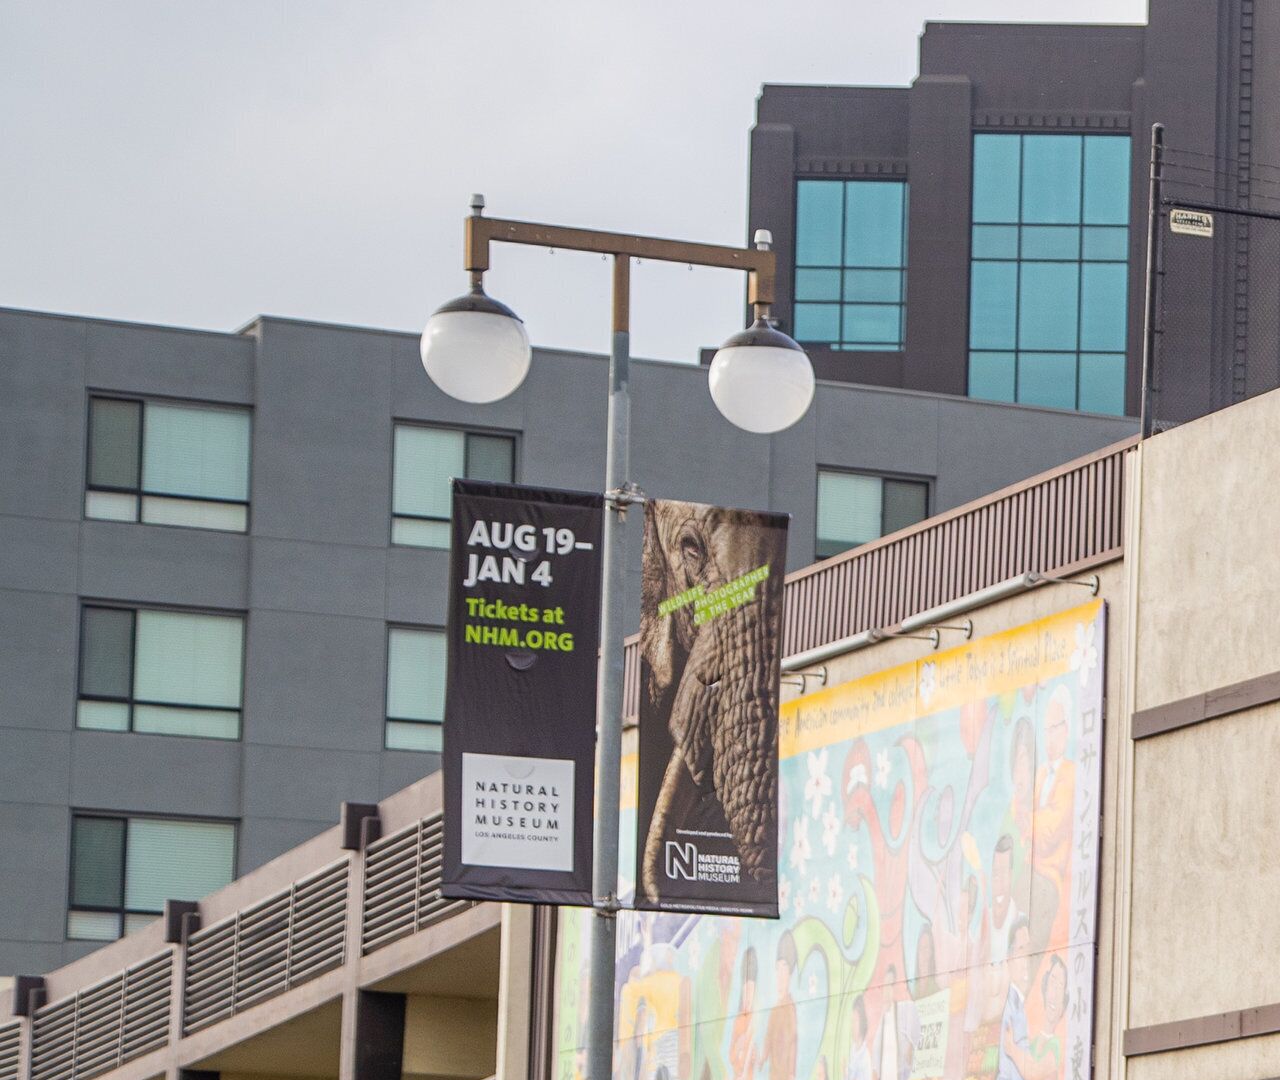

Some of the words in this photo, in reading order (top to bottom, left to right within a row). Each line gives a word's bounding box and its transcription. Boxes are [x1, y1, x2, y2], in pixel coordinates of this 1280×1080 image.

[467, 520, 537, 552] AUG
[463, 554, 526, 588] JAN
[531, 561, 553, 587] 4
[657, 584, 704, 616] WILDLIFE
[694, 567, 769, 609] PHOTOGRAPHER
[709, 601, 728, 617] THE
[730, 586, 755, 604] YEAR
[465, 597, 539, 623] Tickets
[541, 606, 565, 625] at
[465, 624, 574, 652] NHM.ORG
[475, 780, 560, 798] NATURAL
[475, 797, 560, 814] HISTORY
[475, 814, 560, 831] MUSEUM
[475, 831, 489, 840] LOS
[490, 832, 525, 842] ANGELES
[526, 834, 559, 843] COUNTY
[665, 841, 698, 880] N
[698, 854, 740, 864] NATURAL
[698, 863, 740, 874] HISTORY
[698, 872, 740, 883] MUSEUM
